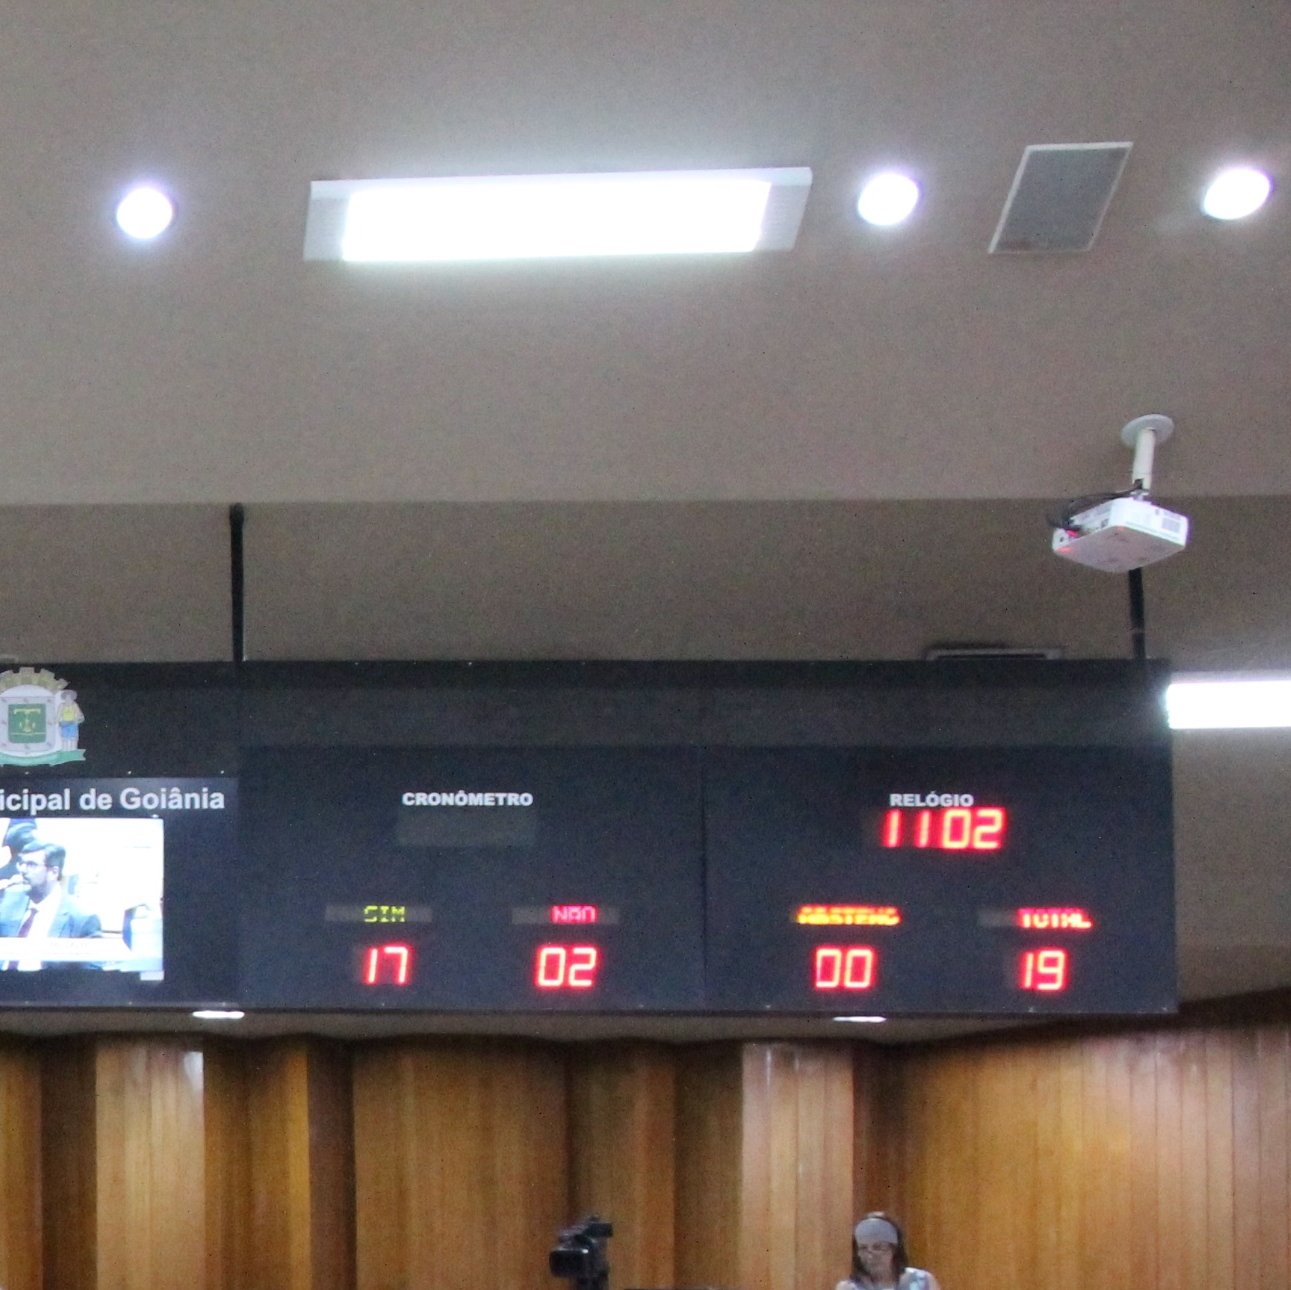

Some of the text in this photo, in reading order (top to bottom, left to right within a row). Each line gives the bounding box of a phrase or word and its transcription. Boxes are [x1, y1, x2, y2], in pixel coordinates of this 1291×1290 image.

[79, 788, 113, 811] de
[119, 786, 226, 811] Goiânia
[401, 790, 534, 807] CRONÔMETRO
[889, 790, 975, 807] RELÓGIO
[365, 945, 412, 986] 17
[534, 945, 599, 988] 02
[813, 947, 877, 990] 00
[1021, 948, 1068, 992] 19
